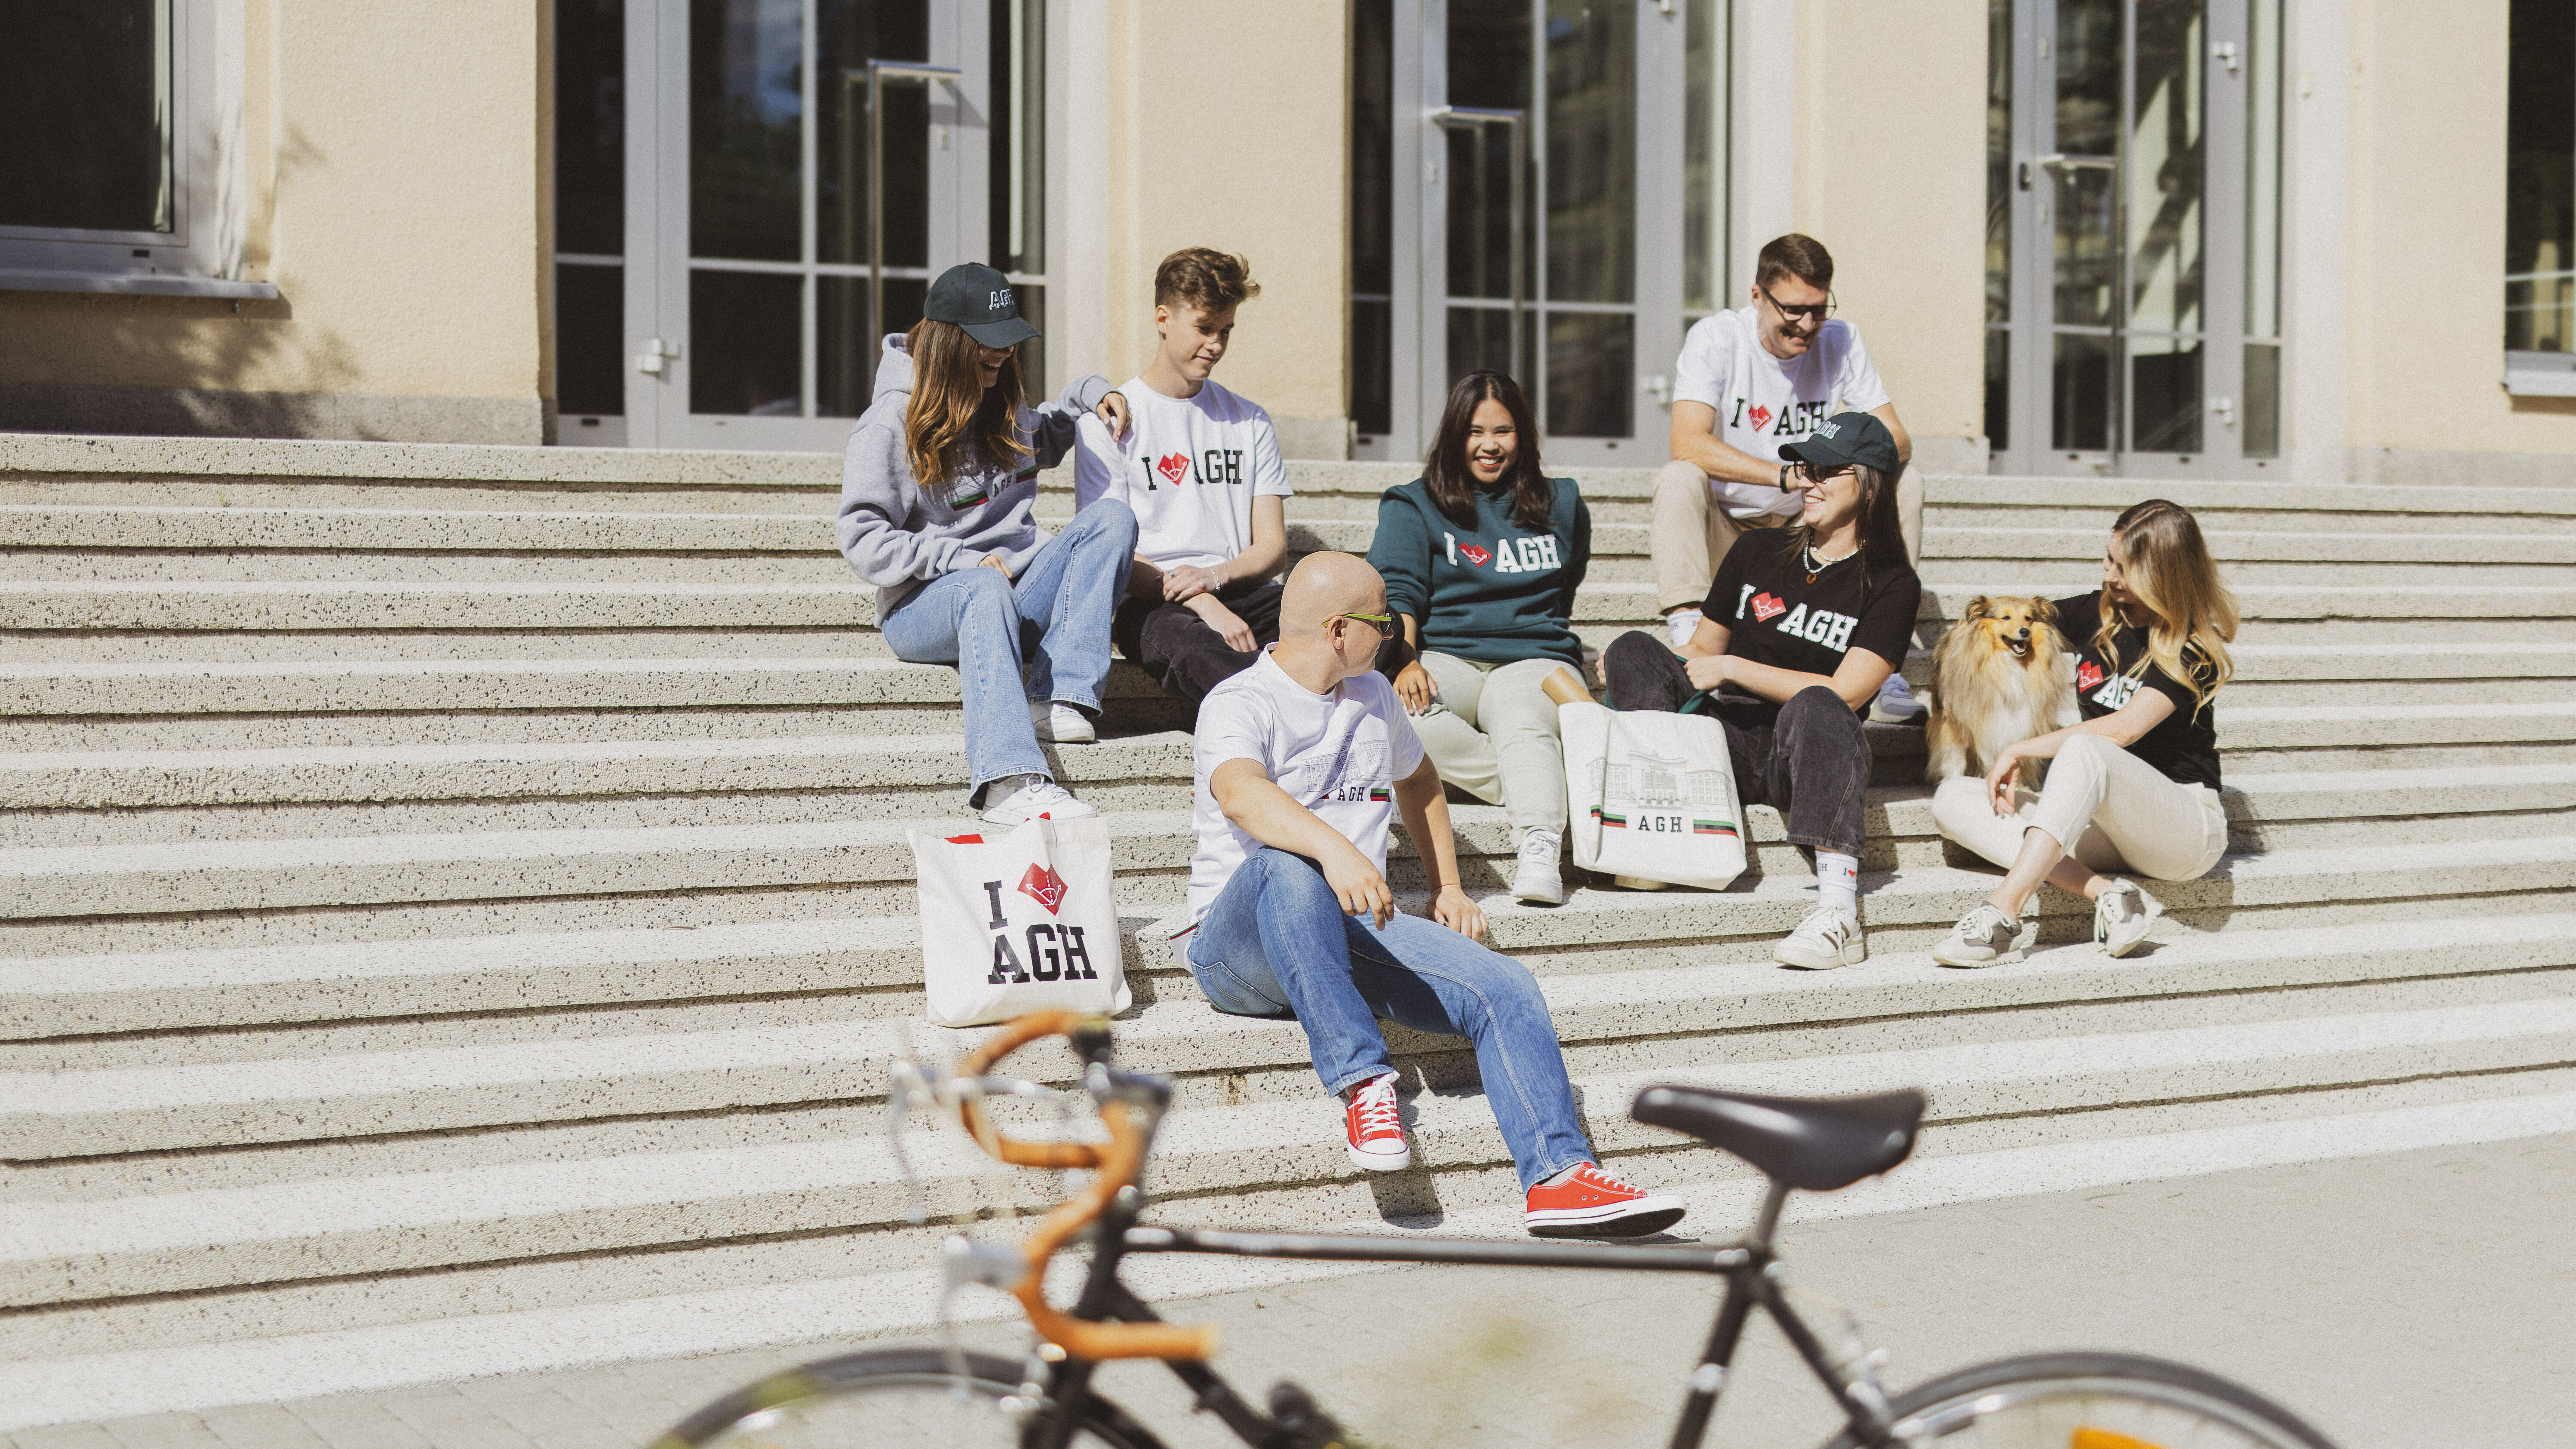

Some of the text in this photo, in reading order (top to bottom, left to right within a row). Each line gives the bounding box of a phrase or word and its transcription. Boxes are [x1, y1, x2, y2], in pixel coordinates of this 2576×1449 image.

[1730, 397, 1827, 436] I AGH
[1142, 457, 1157, 490] I
[1444, 531, 1561, 573] I AGH
[1736, 584, 1858, 653] I AGH
[2092, 672, 2143, 710] AG
[1337, 786, 1365, 801] AGH
[1638, 816, 1682, 832] AGH
[984, 880, 1008, 930] I
[988, 924, 1098, 985] AGH
